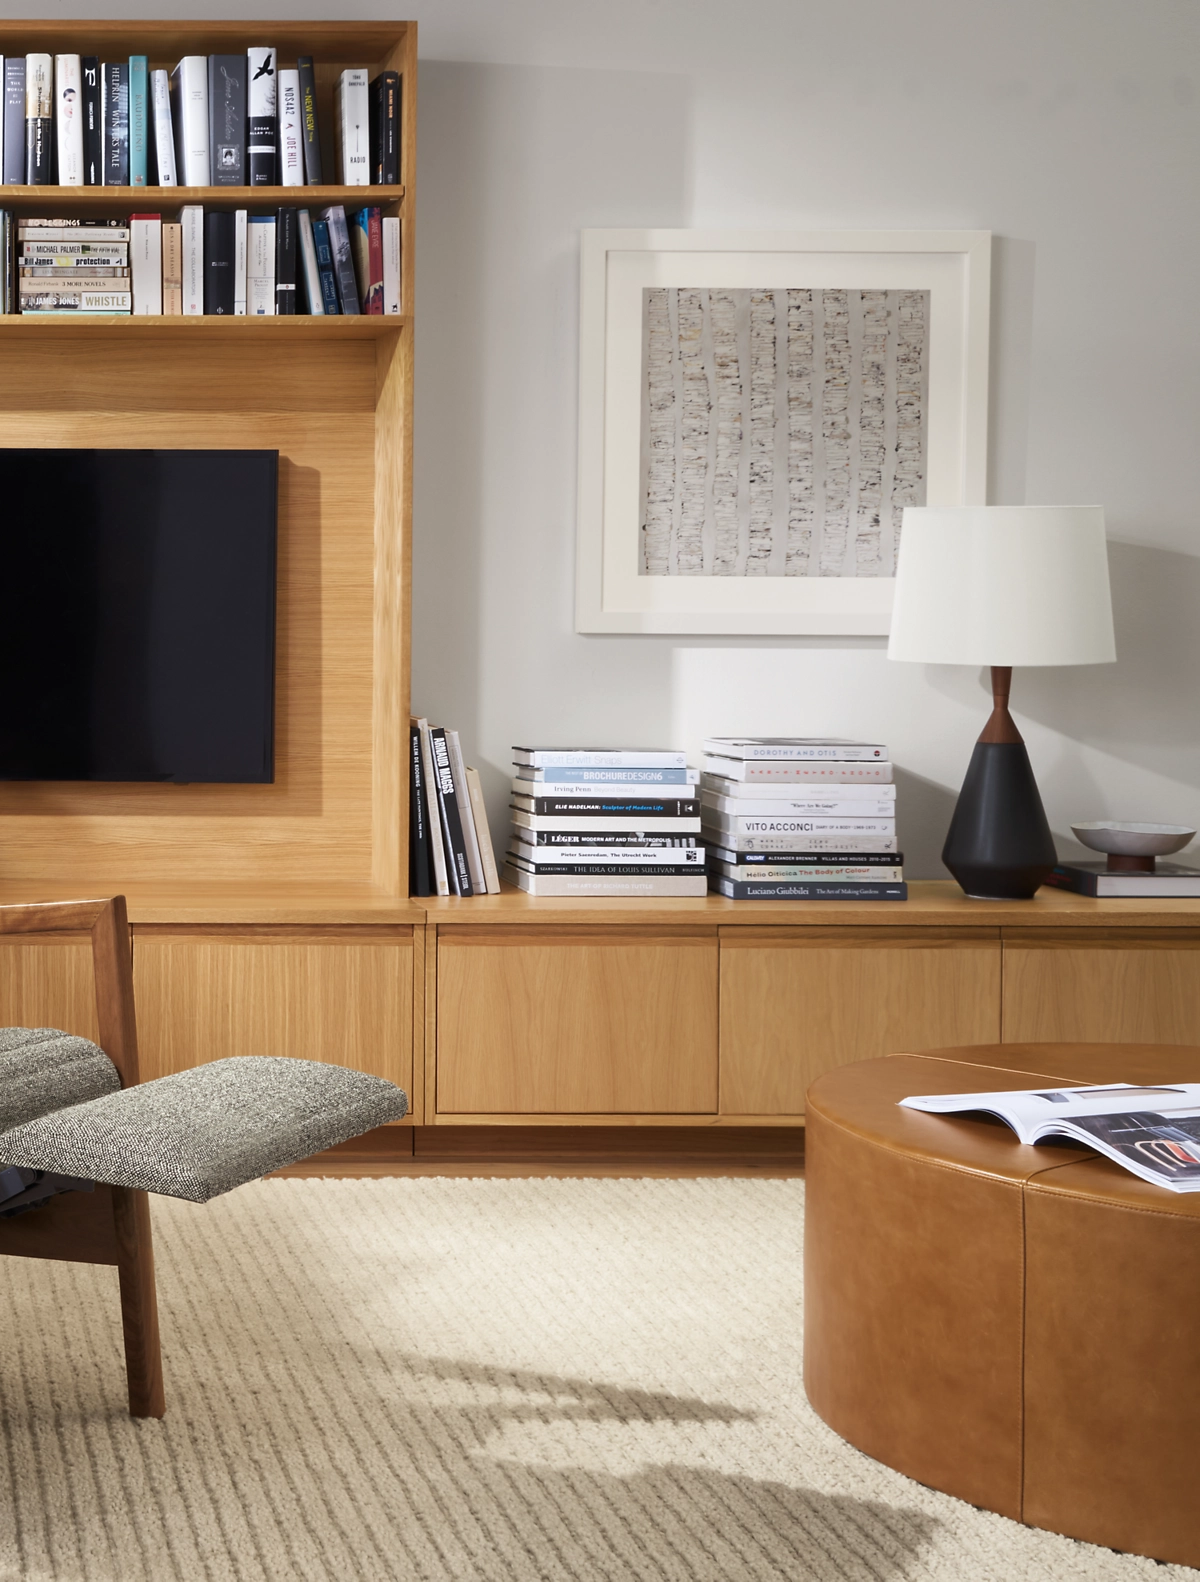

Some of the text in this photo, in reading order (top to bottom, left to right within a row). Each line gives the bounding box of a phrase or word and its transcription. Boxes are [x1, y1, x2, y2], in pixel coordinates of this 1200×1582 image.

[111, 67, 120, 102] HELPRIN
[220, 65, 240, 141] Jane Austen
[284, 87, 295, 115] NOS4A2
[304, 95, 313, 112] NEW
[36, 118, 42, 127] on
[135, 94, 143, 152] BAUDOLINO
[306, 113, 315, 131] NEW
[111, 148, 120, 168] TALE
[286, 136, 297, 168] JOE HILL
[370, 219, 379, 248] JANE EYRE
[36, 245, 81, 254] MICHAEL PALMER
[75, 258, 111, 267] protection
[35, 297, 80, 305] JAMES JONES
[85, 296, 127, 306] WHISTLE
[413, 756, 419, 764] DE
[433, 737, 455, 795] ARNAUD MAGGS
[541, 754, 622, 767] Elliott Erwitt Snaps
[583, 771, 663, 781] BROCHUREDESIGN6
[745, 822, 768, 831] VITO
[769, 822, 814, 831] ACCONCI
[551, 833, 580, 843] LÉGER
[747, 887, 776, 895] Luciano
[776, 887, 809, 895] Giubbilei
